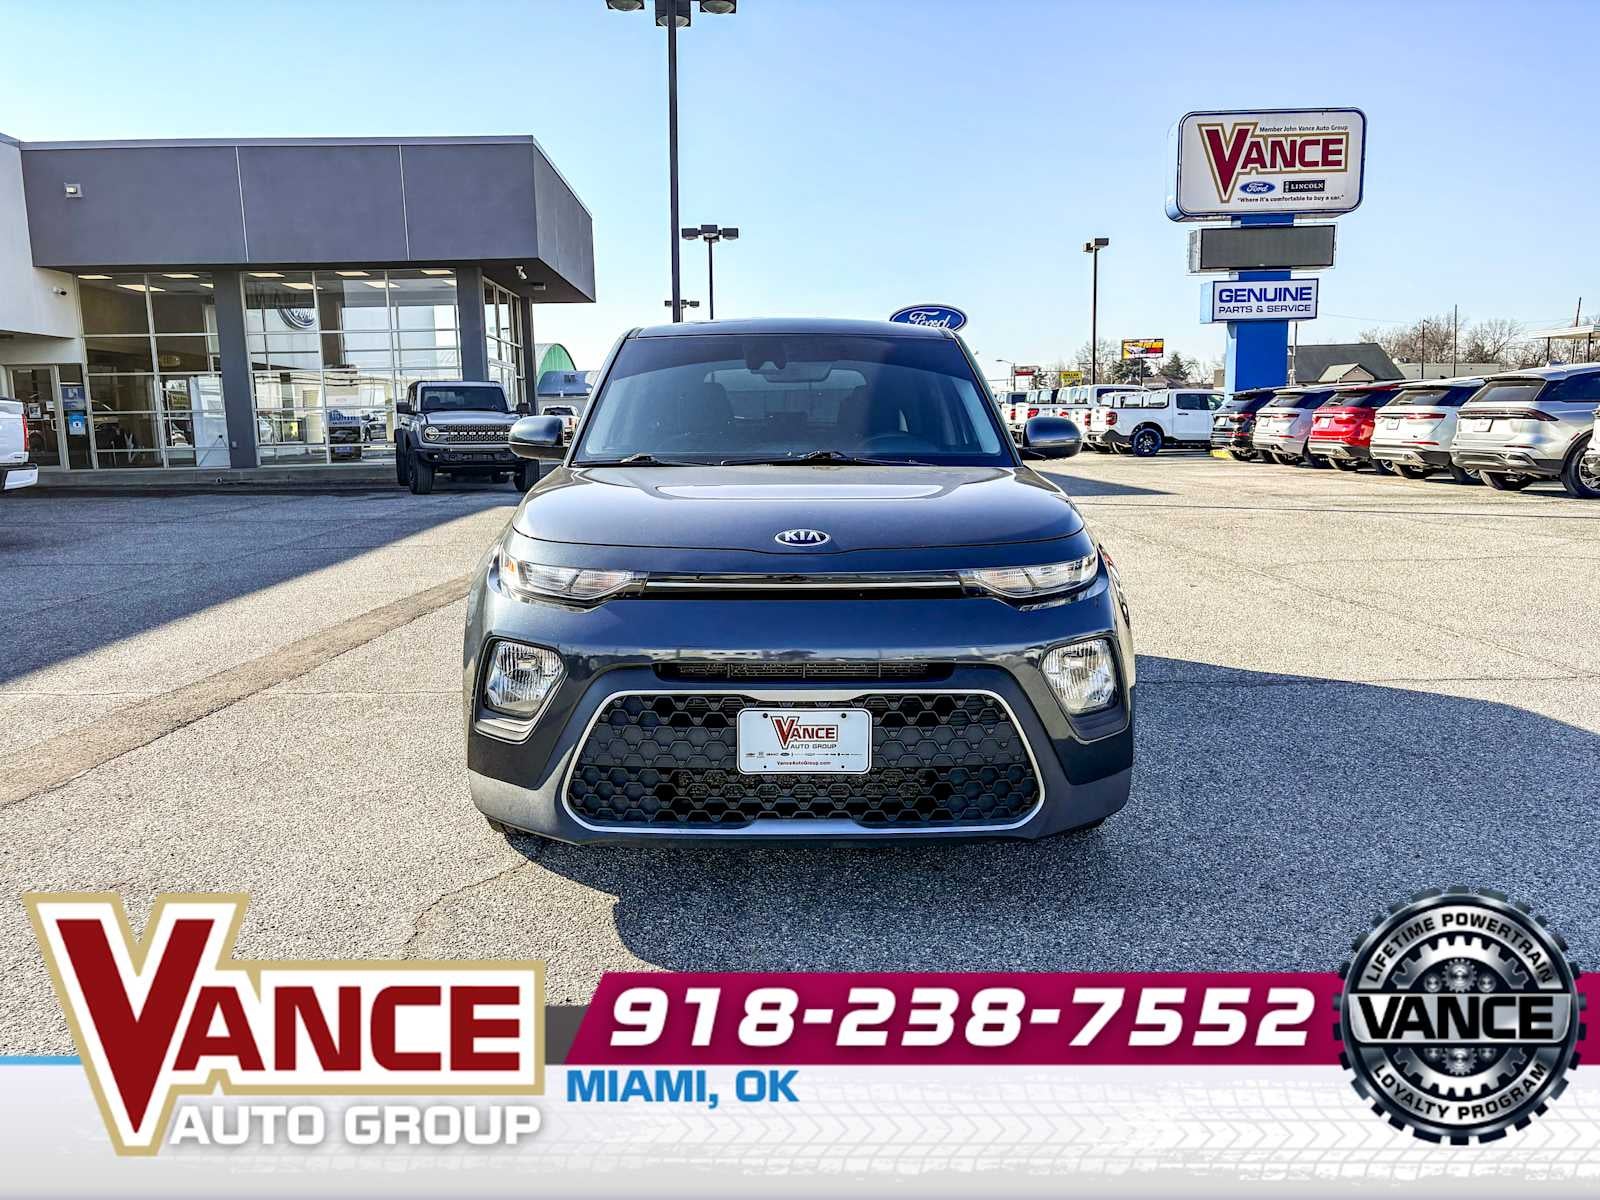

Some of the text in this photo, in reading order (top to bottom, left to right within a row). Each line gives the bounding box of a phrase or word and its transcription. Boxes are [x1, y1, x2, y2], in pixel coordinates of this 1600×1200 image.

[1246, 182, 1270, 193] Ford
[1290, 182, 1324, 191] LINCOLN
[1218, 286, 1312, 303] GENUINE
[1218, 304, 1311, 314] PARTS & SERVICE
[907, 311, 951, 328] Ford
[785, 531, 821, 541] KIA
[773, 718, 836, 747] VANCE
